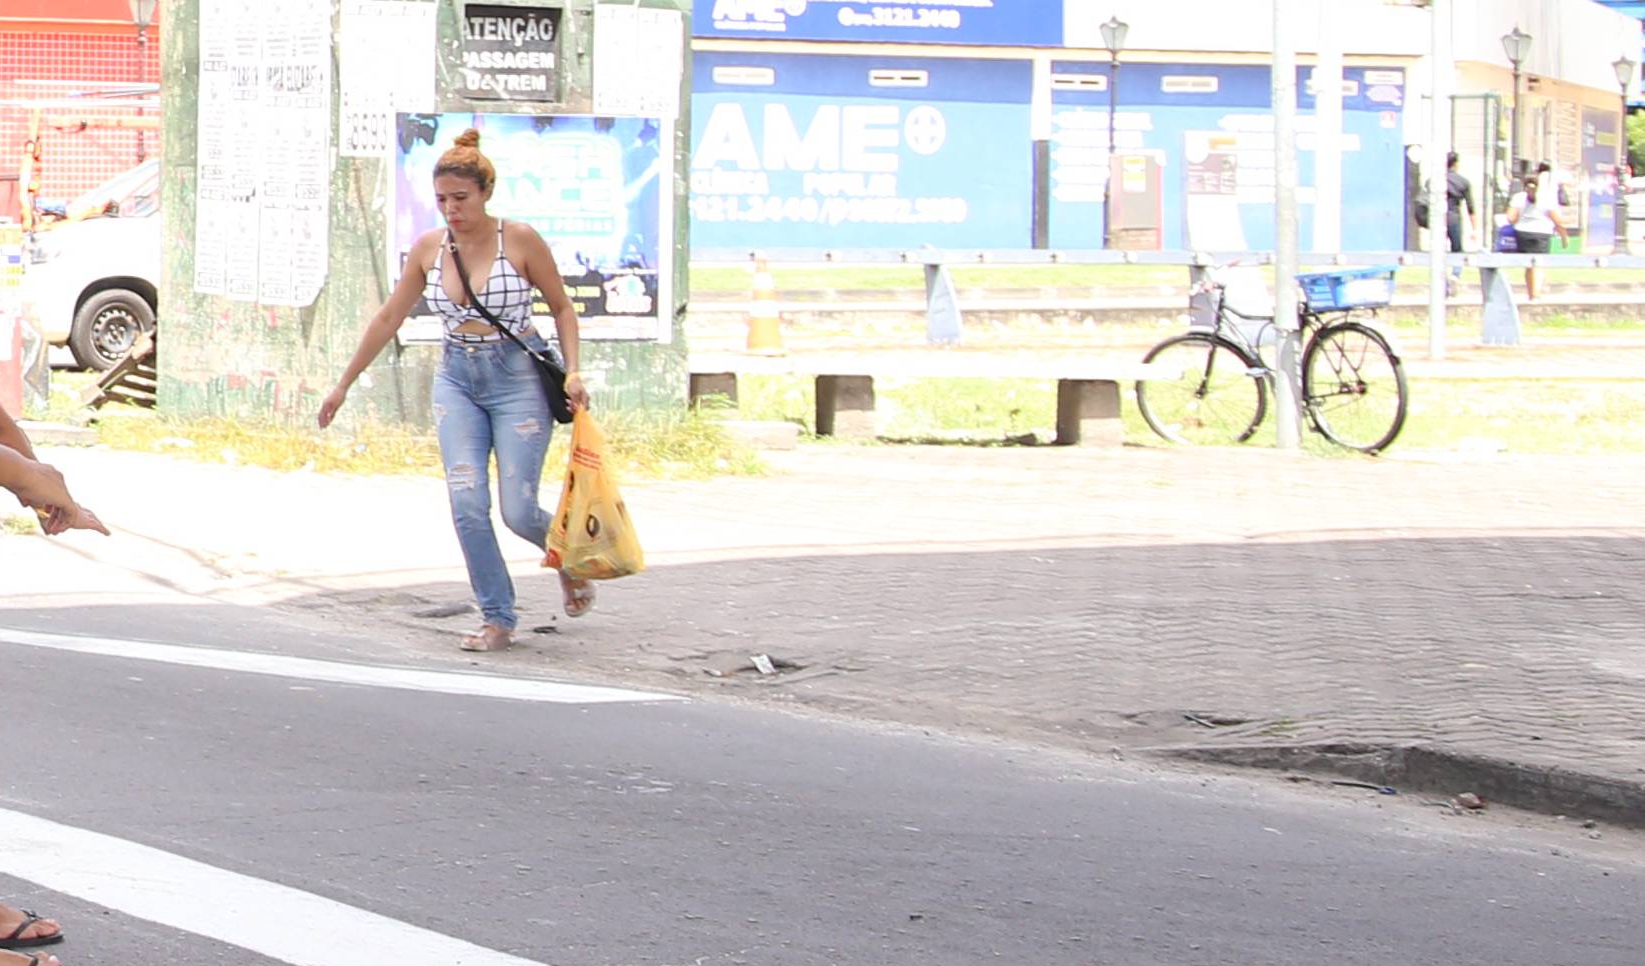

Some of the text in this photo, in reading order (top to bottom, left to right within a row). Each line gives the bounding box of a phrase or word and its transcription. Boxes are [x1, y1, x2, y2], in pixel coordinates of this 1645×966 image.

[462, 13, 554, 46] ATENÇÃO
[495, 74, 547, 91] TREM
[691, 102, 900, 172] AME
